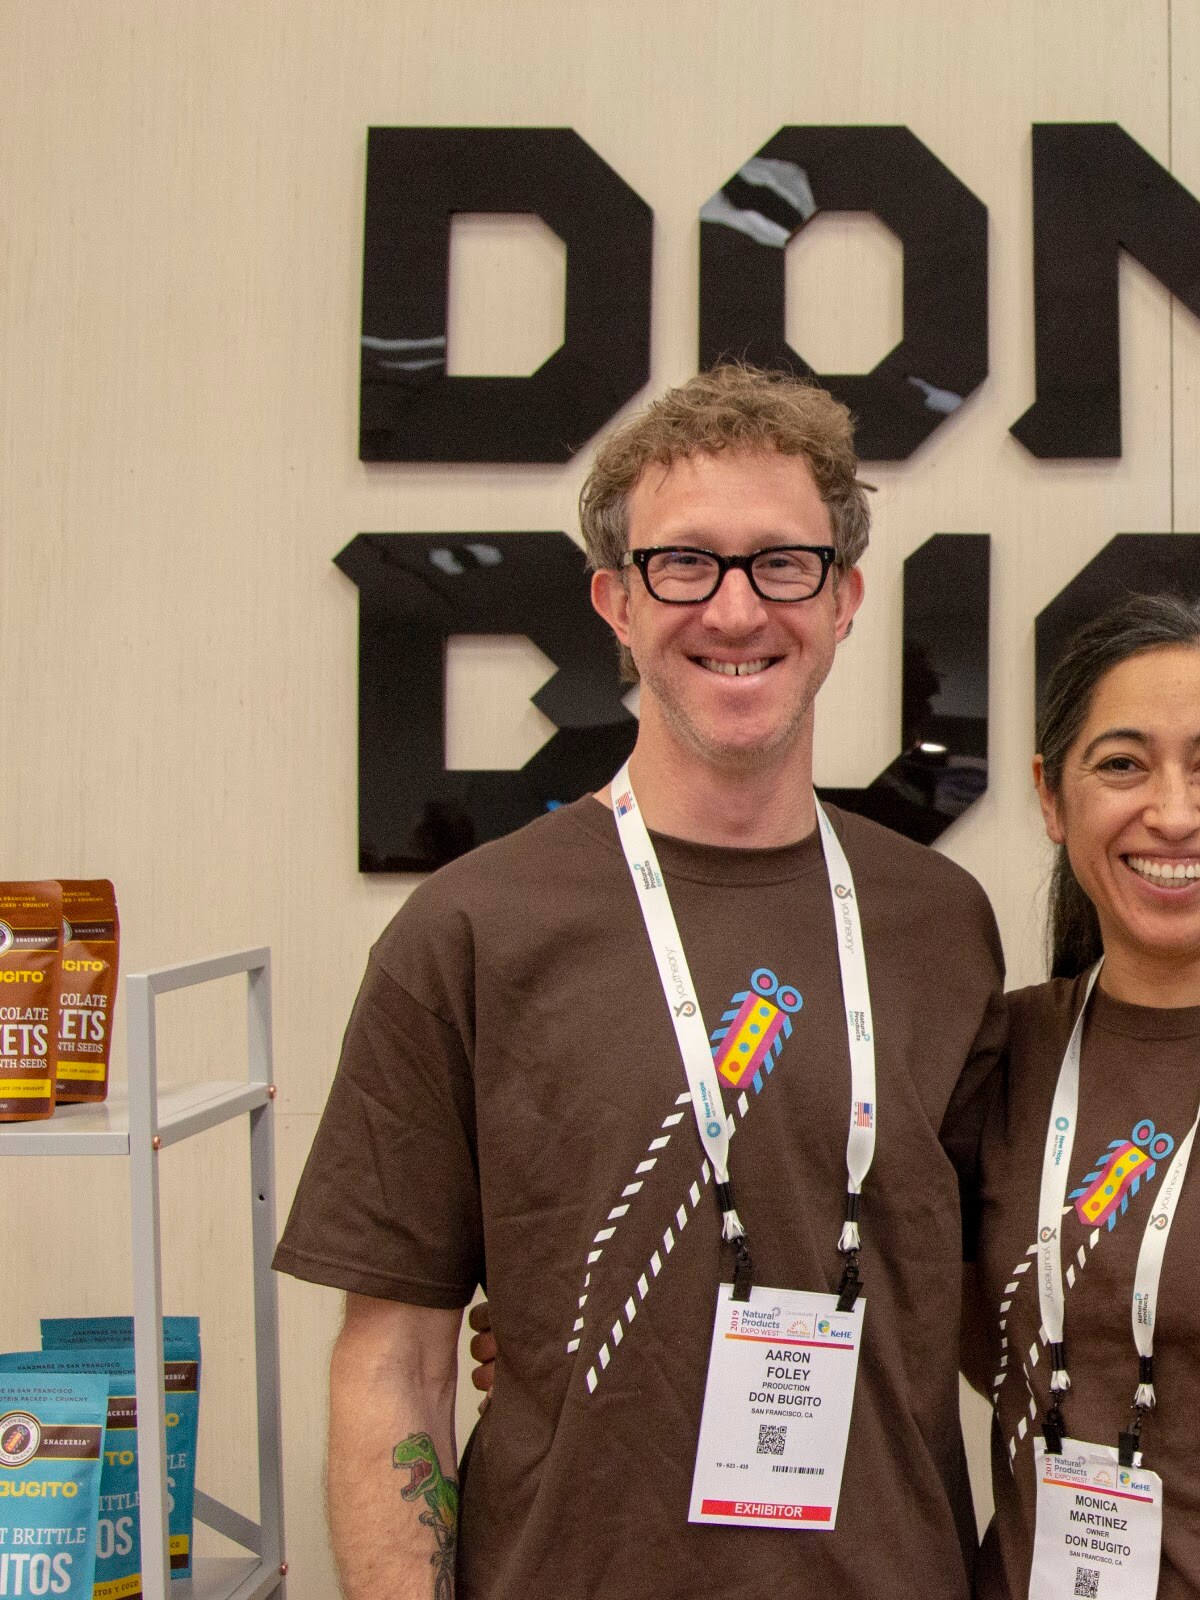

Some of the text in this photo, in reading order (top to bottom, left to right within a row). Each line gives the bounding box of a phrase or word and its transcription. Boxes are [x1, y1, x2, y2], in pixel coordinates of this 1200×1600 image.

[62, 961, 104, 972] GITO
[0, 971, 44, 983] GITO
[60, 993, 107, 1008] COLATE
[0, 1007, 48, 1020] COLATE
[77, 1043, 104, 1053] SEEDS
[20, 1059, 47, 1069] SEEDS
[742, 1309, 775, 1320] Natural
[730, 1310, 739, 1331] 2019
[741, 1318, 780, 1329] Products
[830, 1330, 852, 1339] KeHE
[765, 1350, 811, 1363] AARON
[766, 1367, 811, 1381] FOLEY
[762, 1382, 810, 1392] PRODUCTION
[749, 1392, 822, 1407] DON BUGITO
[1054, 1457, 1081, 1468] Natural
[1054, 1465, 1087, 1476] Products
[1072, 1475, 1087, 1483] WEST
[1130, 1482, 1151, 1491] KeHE
[1075, 1494, 1118, 1513] MONICA
[734, 1502, 803, 1518] EXHIBITOR
[1069, 1510, 1127, 1531] MARTINEZ
[13, 1528, 87, 1545] BRITTLE
[1086, 1527, 1109, 1538] OWNER
[1065, 1534, 1131, 1556] DON BUGITO
